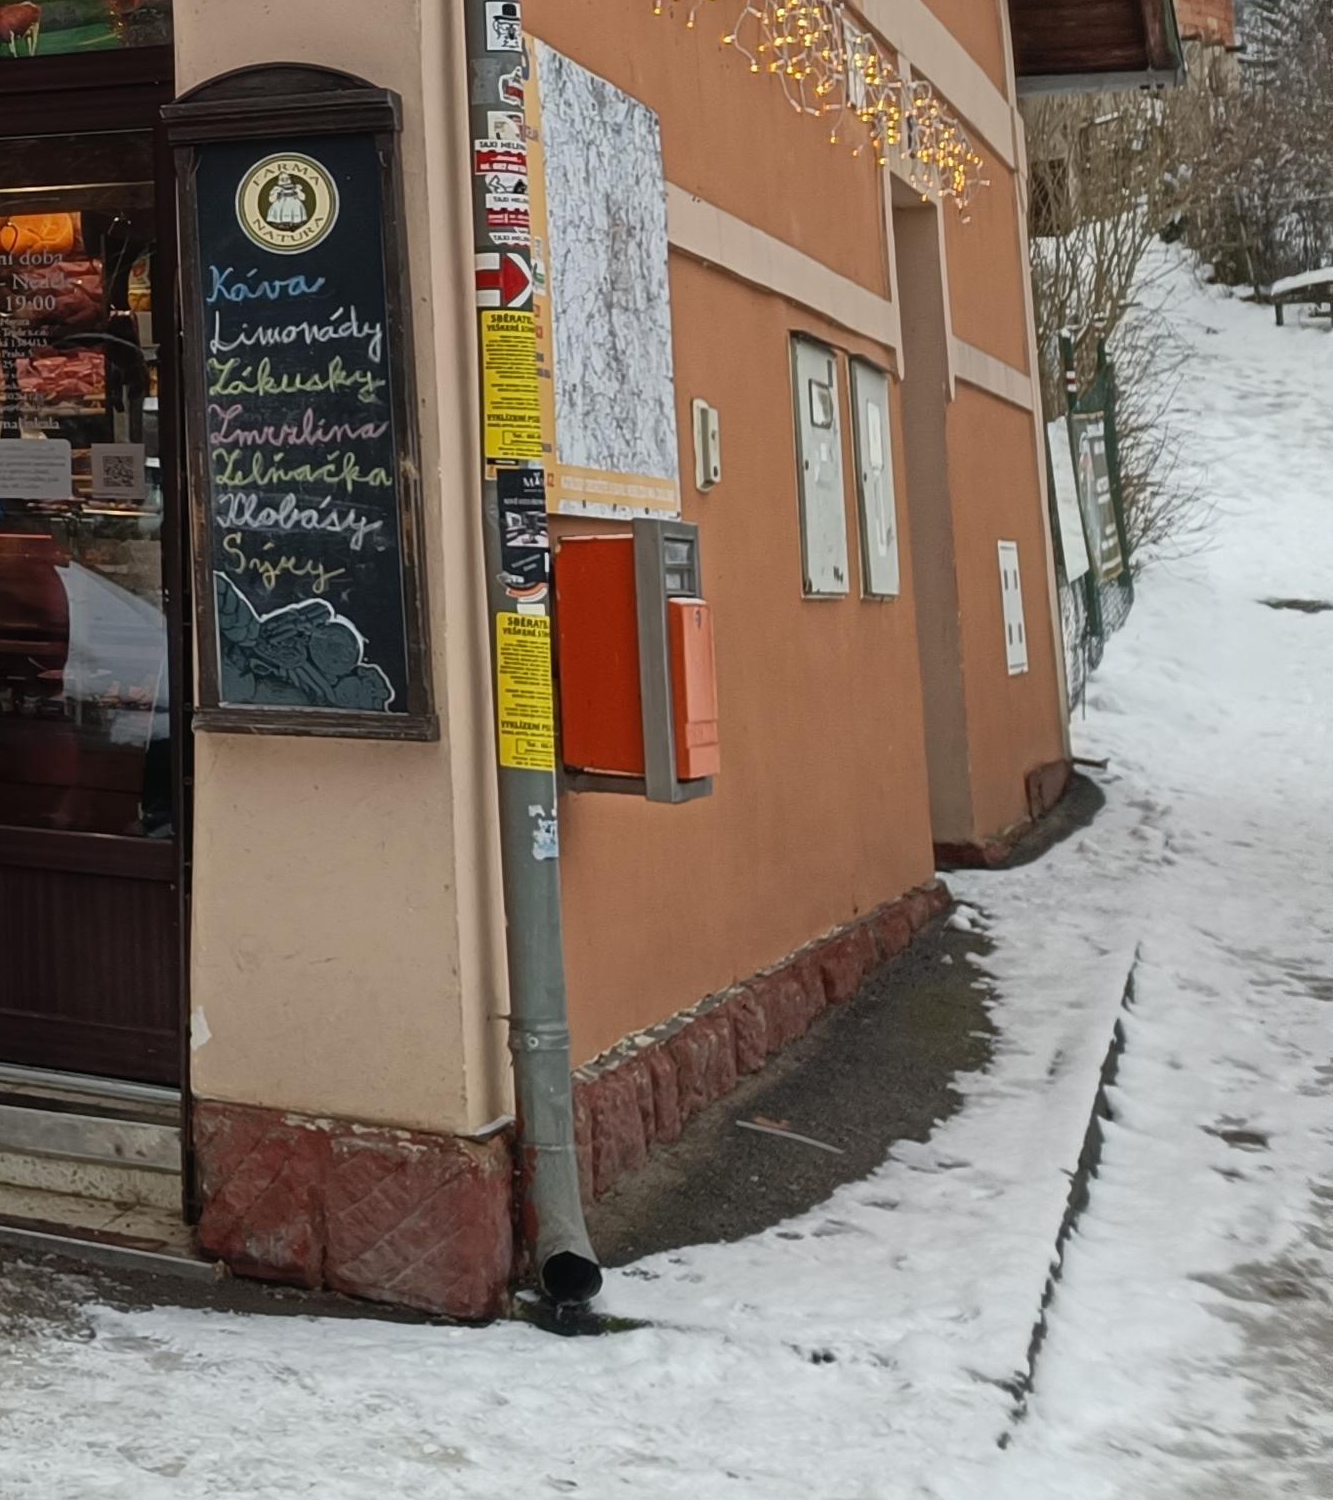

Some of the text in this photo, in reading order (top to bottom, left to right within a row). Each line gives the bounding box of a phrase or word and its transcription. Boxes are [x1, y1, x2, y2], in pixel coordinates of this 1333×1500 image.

[253, 163, 320, 186] FARMA
[253, 217, 324, 242] NATURA
[19, 249, 63, 266] doba
[206, 265, 325, 303] Káva
[6, 296, 56, 312] 19:00
[490, 312, 533, 325] SBĚRATE
[210, 305, 382, 363] Limonády
[208, 356, 386, 404] Zákusky
[208, 403, 389, 449] Zmrzlina
[213, 448, 393, 493] Zelňačka
[217, 493, 384, 550] Klobásy
[222, 533, 346, 593] Sýry
[507, 616, 549, 630] SBĚRATE
